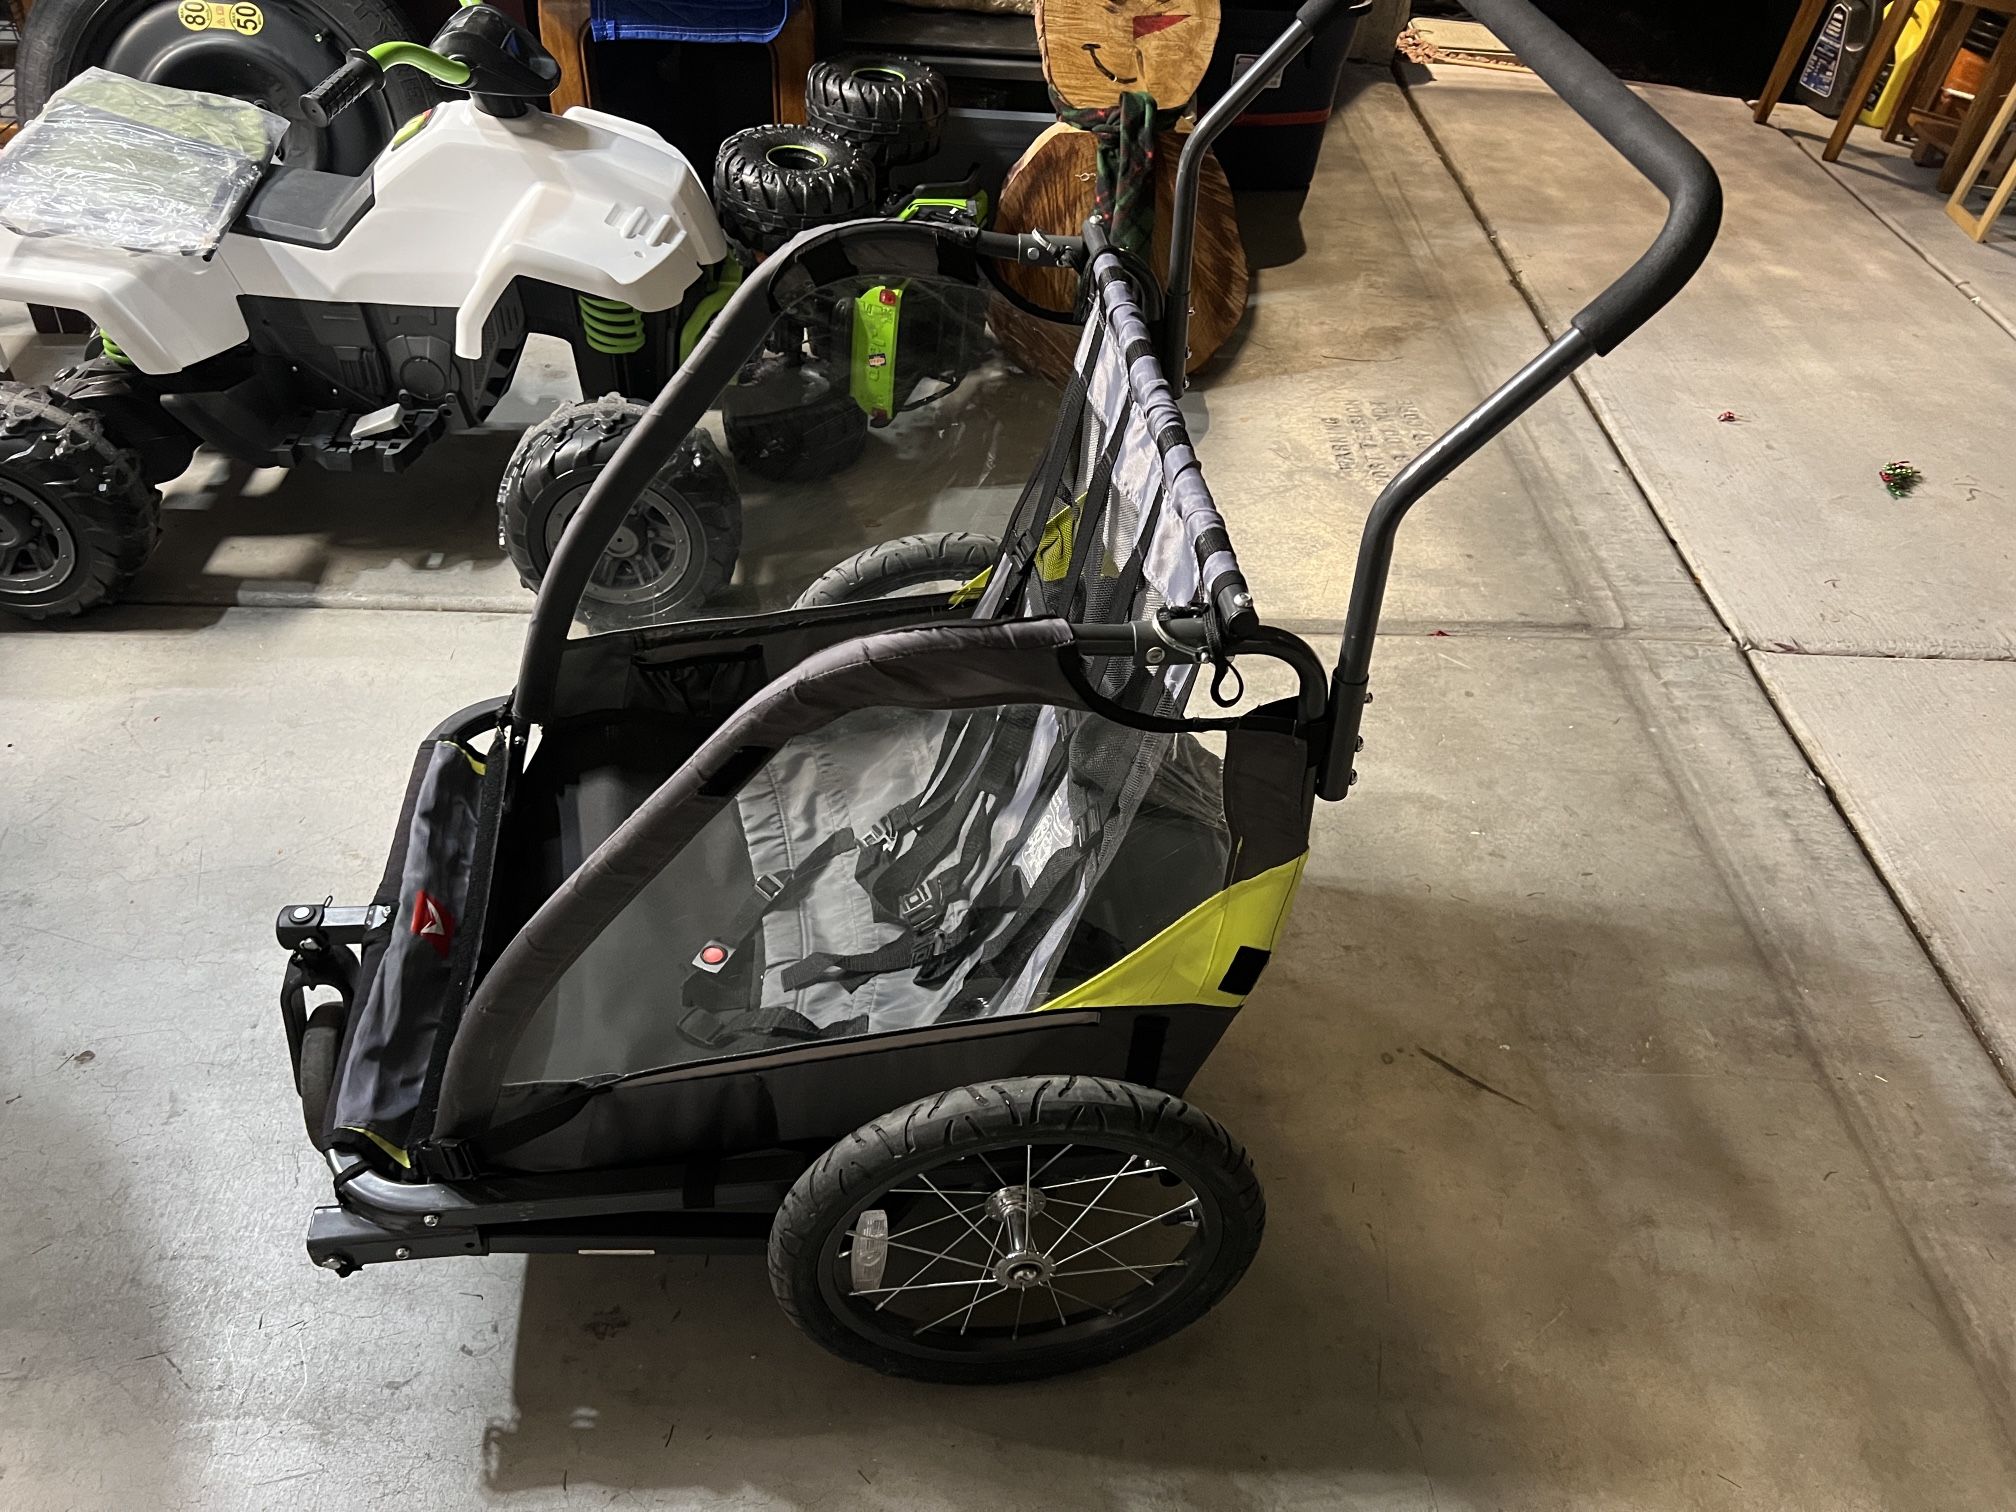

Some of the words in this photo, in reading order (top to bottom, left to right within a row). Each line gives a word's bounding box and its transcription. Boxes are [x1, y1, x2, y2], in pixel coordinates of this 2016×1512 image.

[184, 2, 206, 26] 80
[236, 6, 257, 31] 50
[1320, 416, 1354, 470] WARNING
